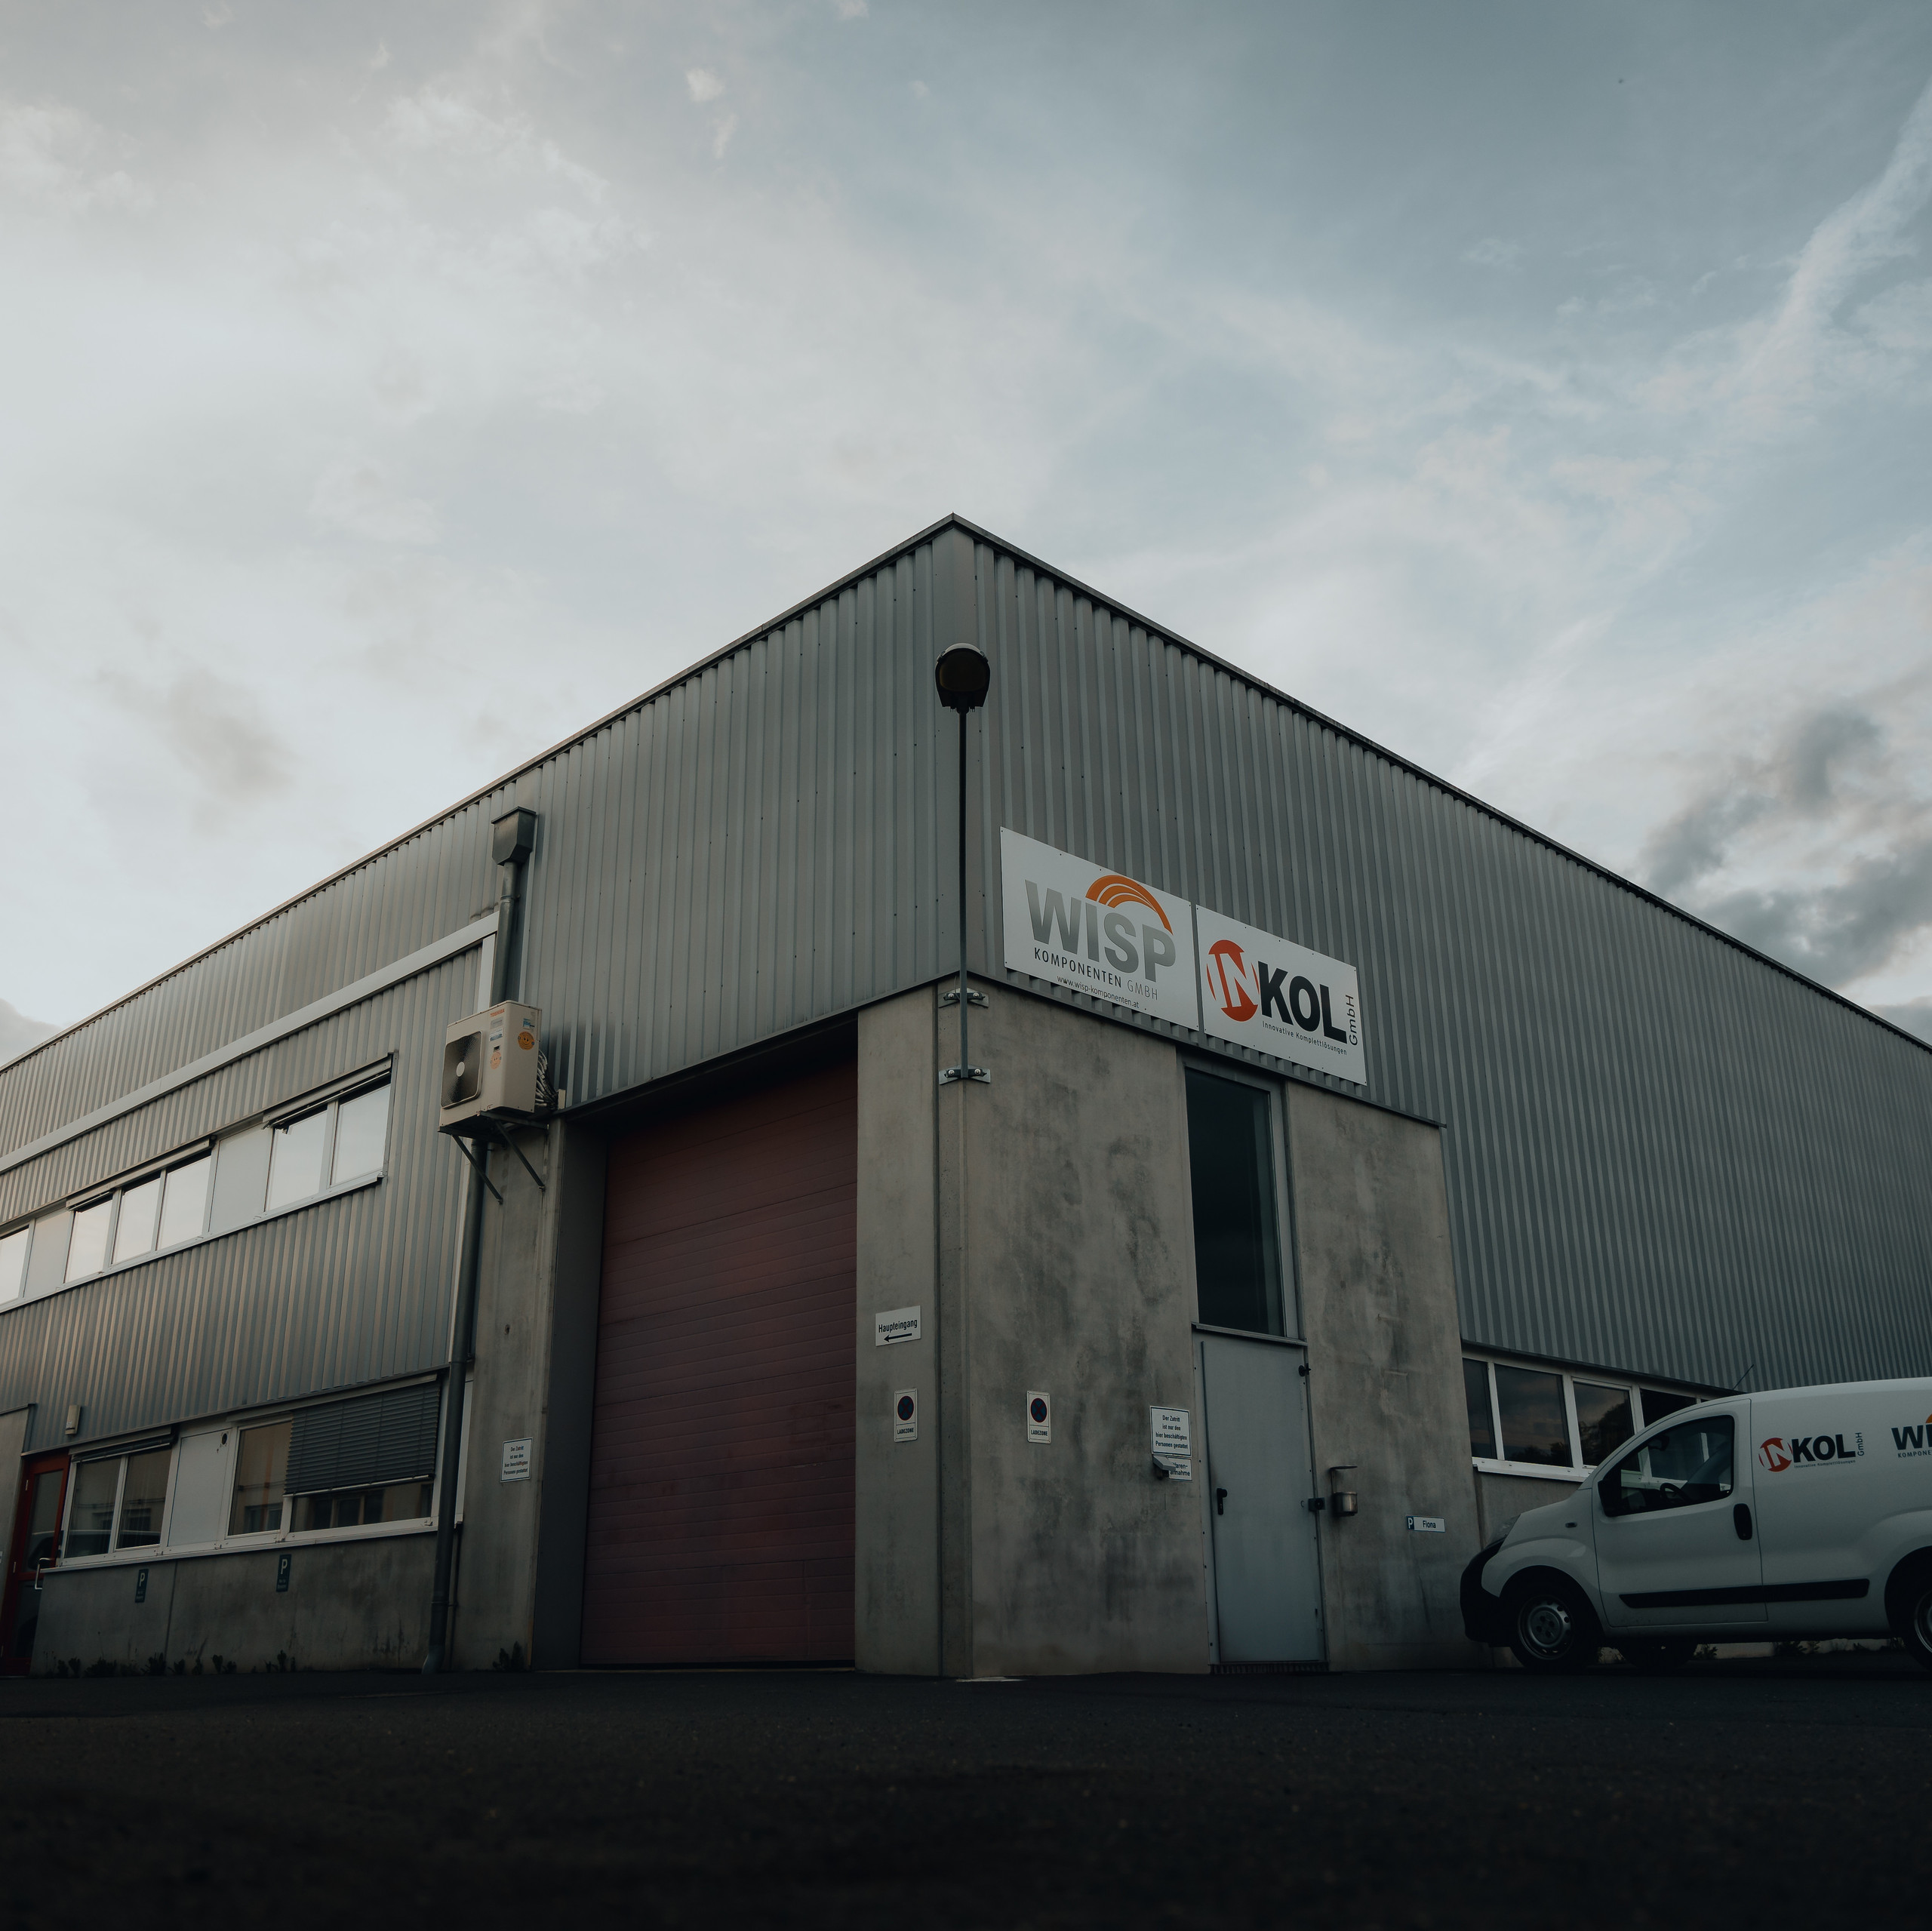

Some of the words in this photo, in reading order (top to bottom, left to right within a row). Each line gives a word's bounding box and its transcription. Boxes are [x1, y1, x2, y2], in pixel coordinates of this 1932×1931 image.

[1025, 879, 1176, 982] WISP
[1034, 947, 1122, 988] KOMPONENTEN
[1127, 979, 1158, 1001] GMBH
[1057, 976, 1140, 1009] www.wisp-komponenten.at
[1345, 994, 1358, 1046] GmbH
[1263, 1021, 1294, 1038] Innovative
[1296, 1032, 1347, 1056] Komplettlösungen
[878, 1319, 918, 1333] Haupteingang
[1855, 1432, 1864, 1456] GmbH
[1897, 1450, 1932, 1458] KOMPONE
